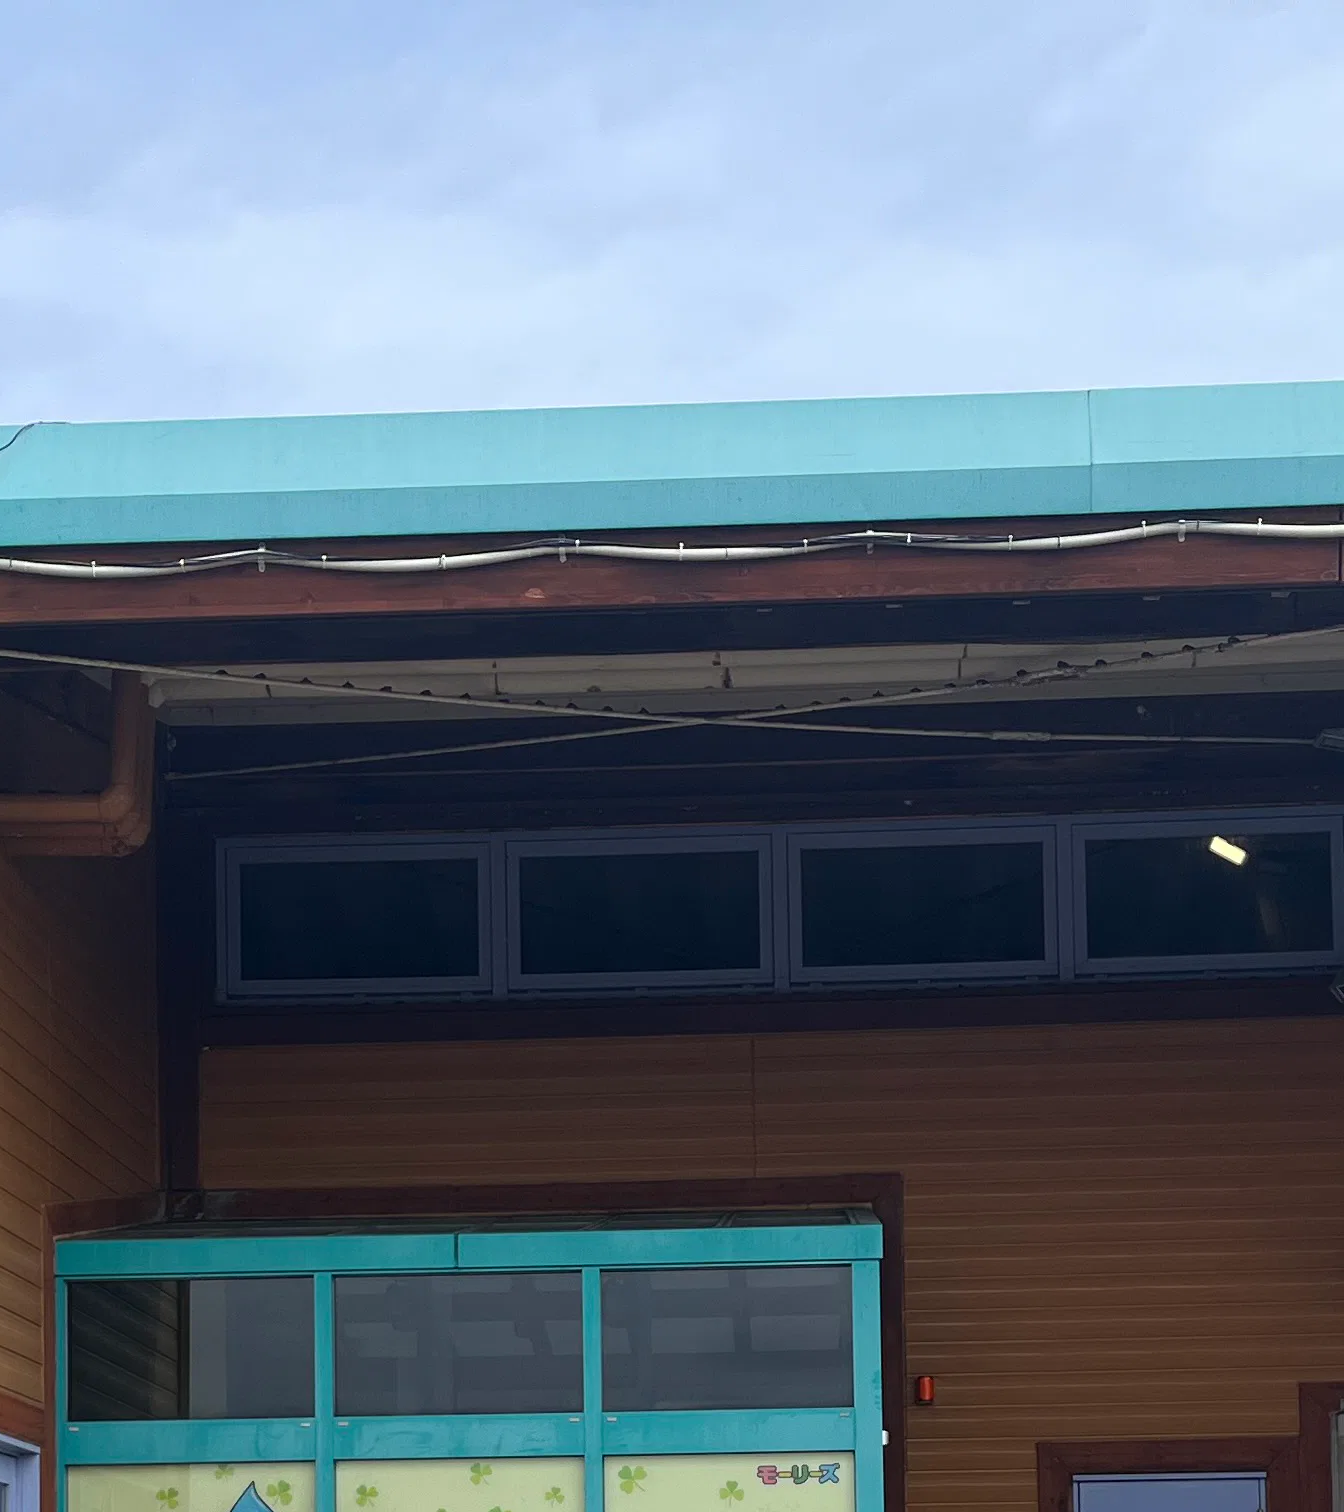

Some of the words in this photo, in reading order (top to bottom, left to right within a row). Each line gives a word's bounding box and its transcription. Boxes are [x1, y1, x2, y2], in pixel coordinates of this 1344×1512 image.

[757, 1463, 840, 1485] モーリーズ
